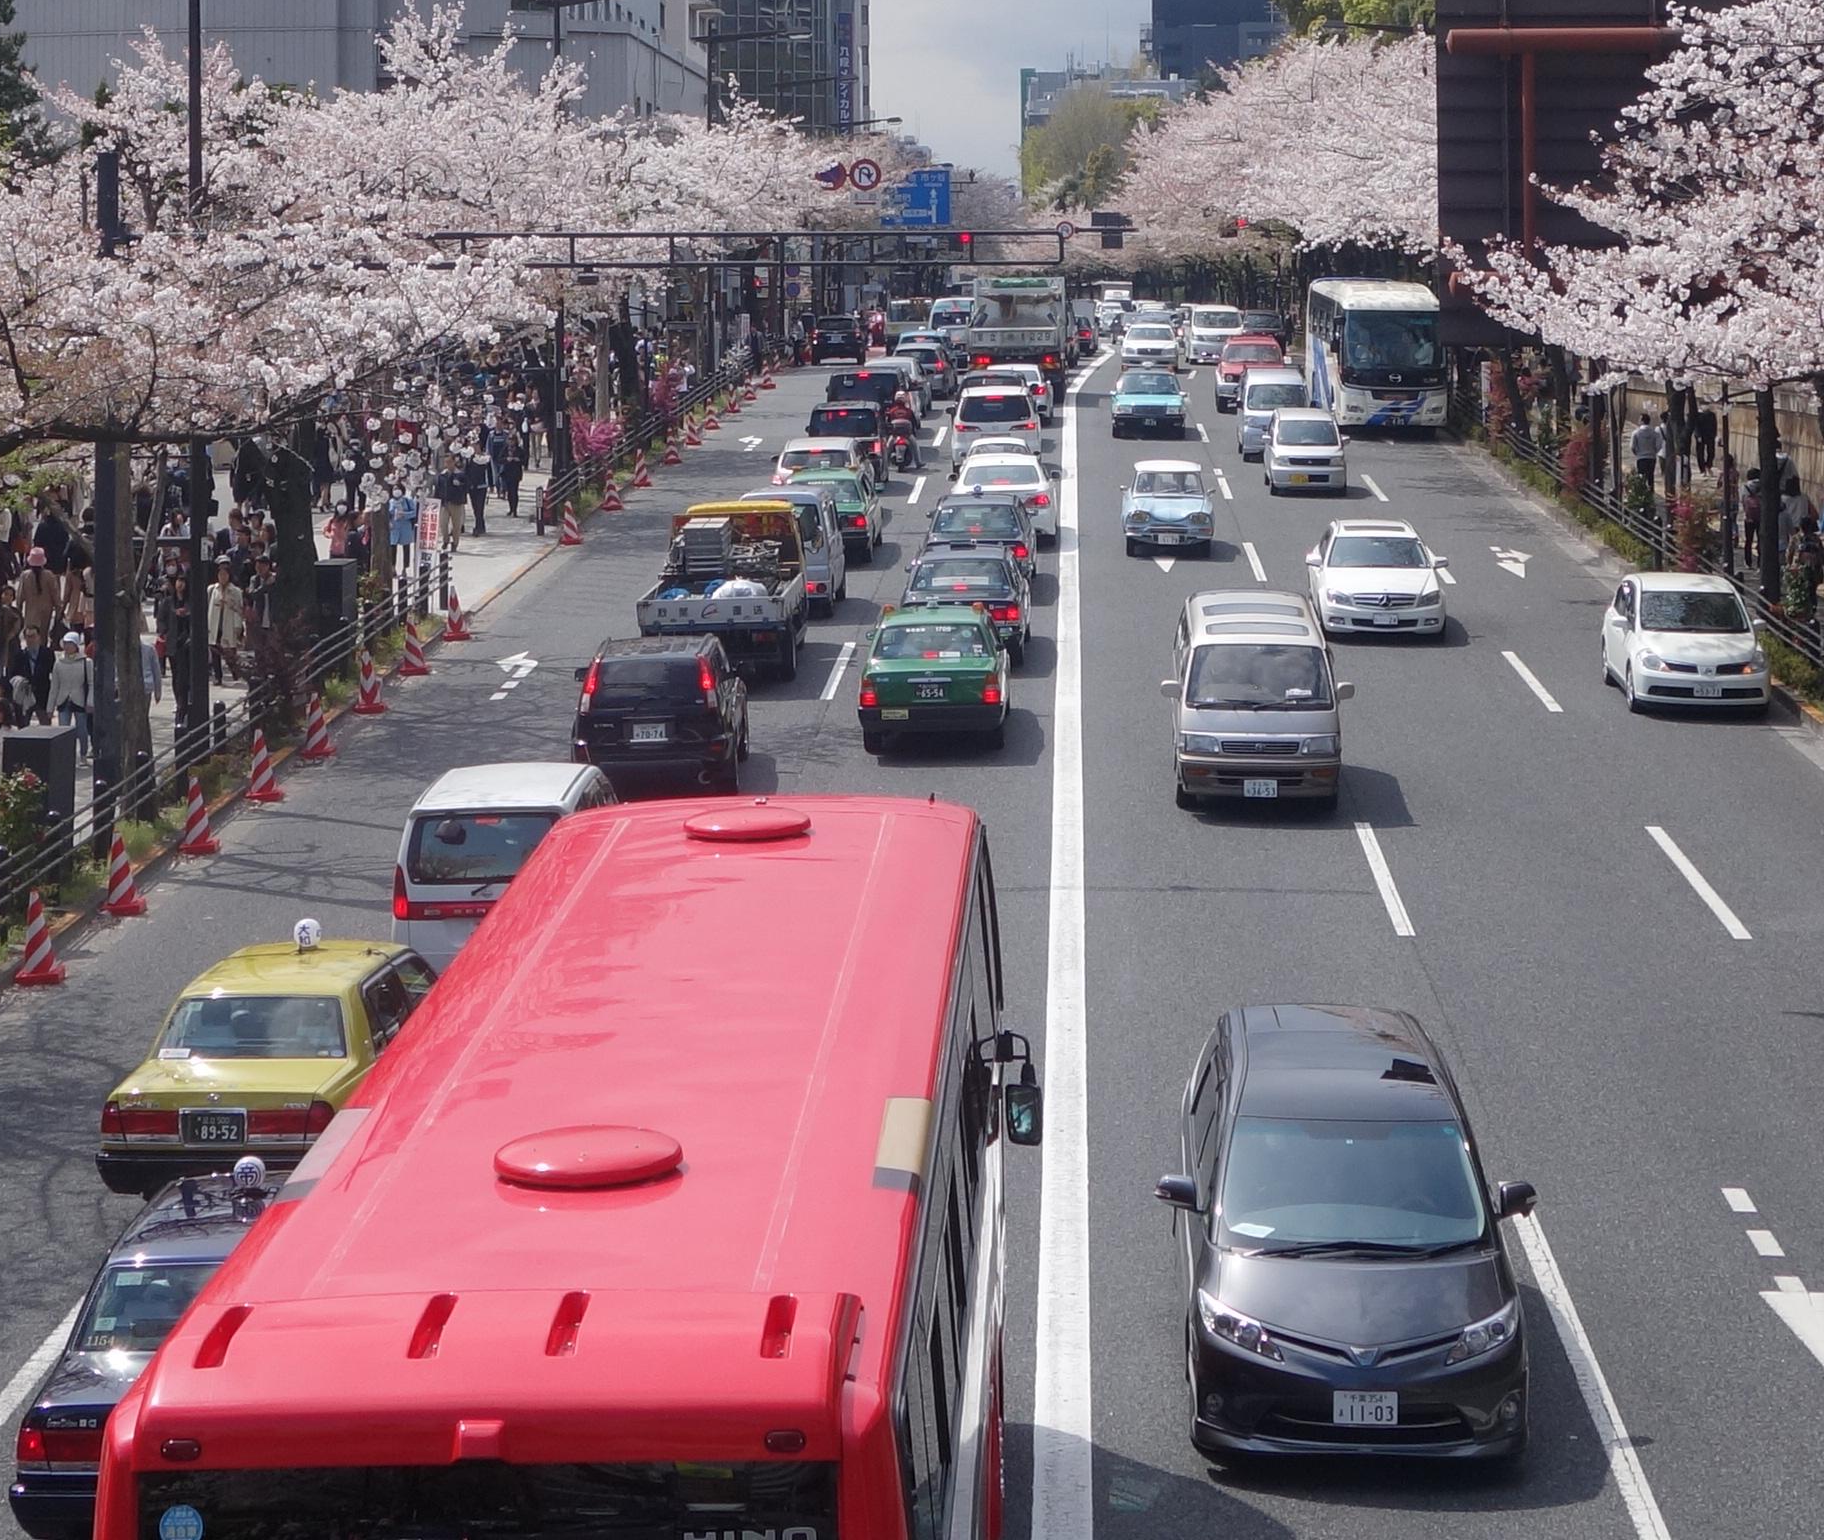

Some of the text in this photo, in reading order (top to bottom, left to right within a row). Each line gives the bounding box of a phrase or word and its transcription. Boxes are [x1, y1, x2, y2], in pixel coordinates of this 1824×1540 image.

[297, 923, 311, 946] 大和
[201, 1125, 238, 1140] 89-52
[1350, 1405, 1394, 1421] 11-03
